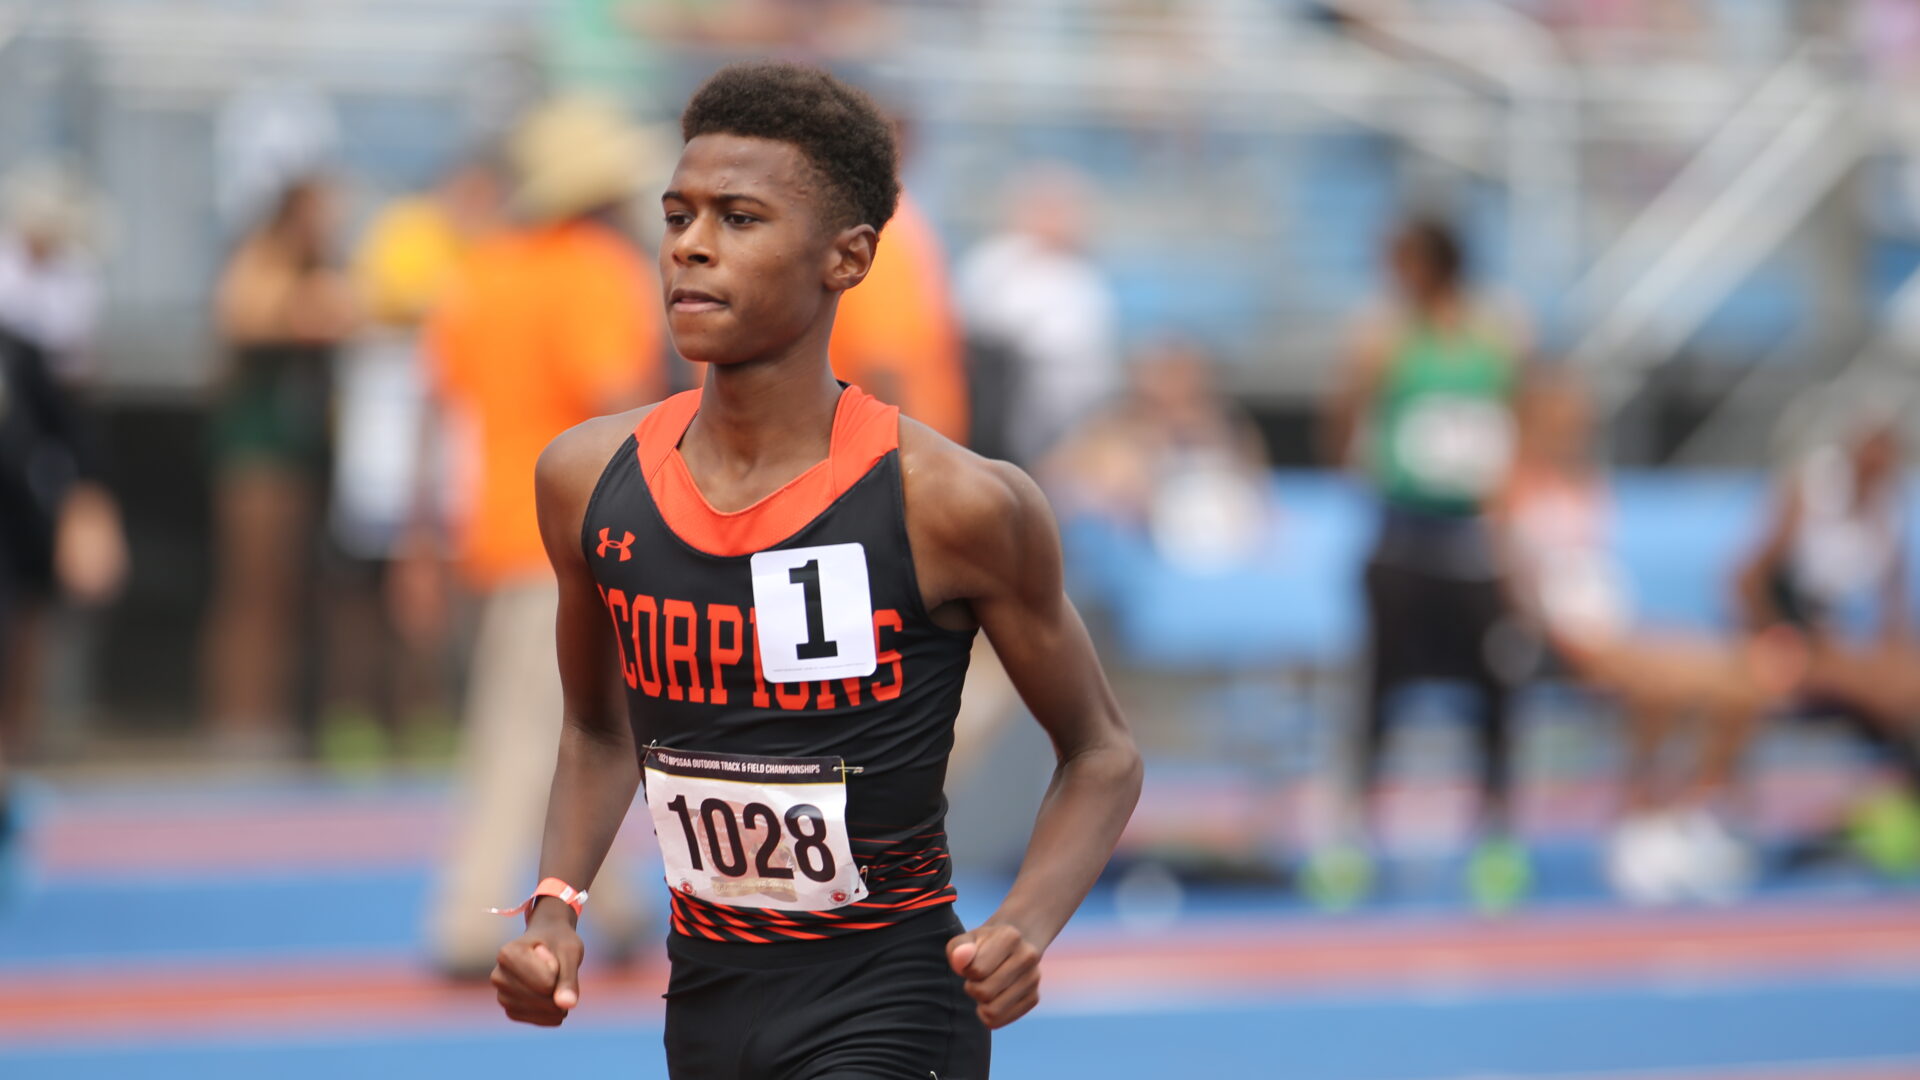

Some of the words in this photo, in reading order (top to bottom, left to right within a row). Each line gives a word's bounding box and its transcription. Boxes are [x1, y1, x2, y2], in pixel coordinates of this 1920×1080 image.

[788, 559, 838, 660] 1
[668, 755, 692, 767] MPSSAA
[692, 758, 720, 770] OUTDOOR
[720, 761, 741, 772] TRACK
[741, 763, 747, 773] &
[747, 763, 765, 774] FIELD
[765, 764, 821, 775] CHAMPIONSHIPS
[667, 794, 836, 882] 1028
